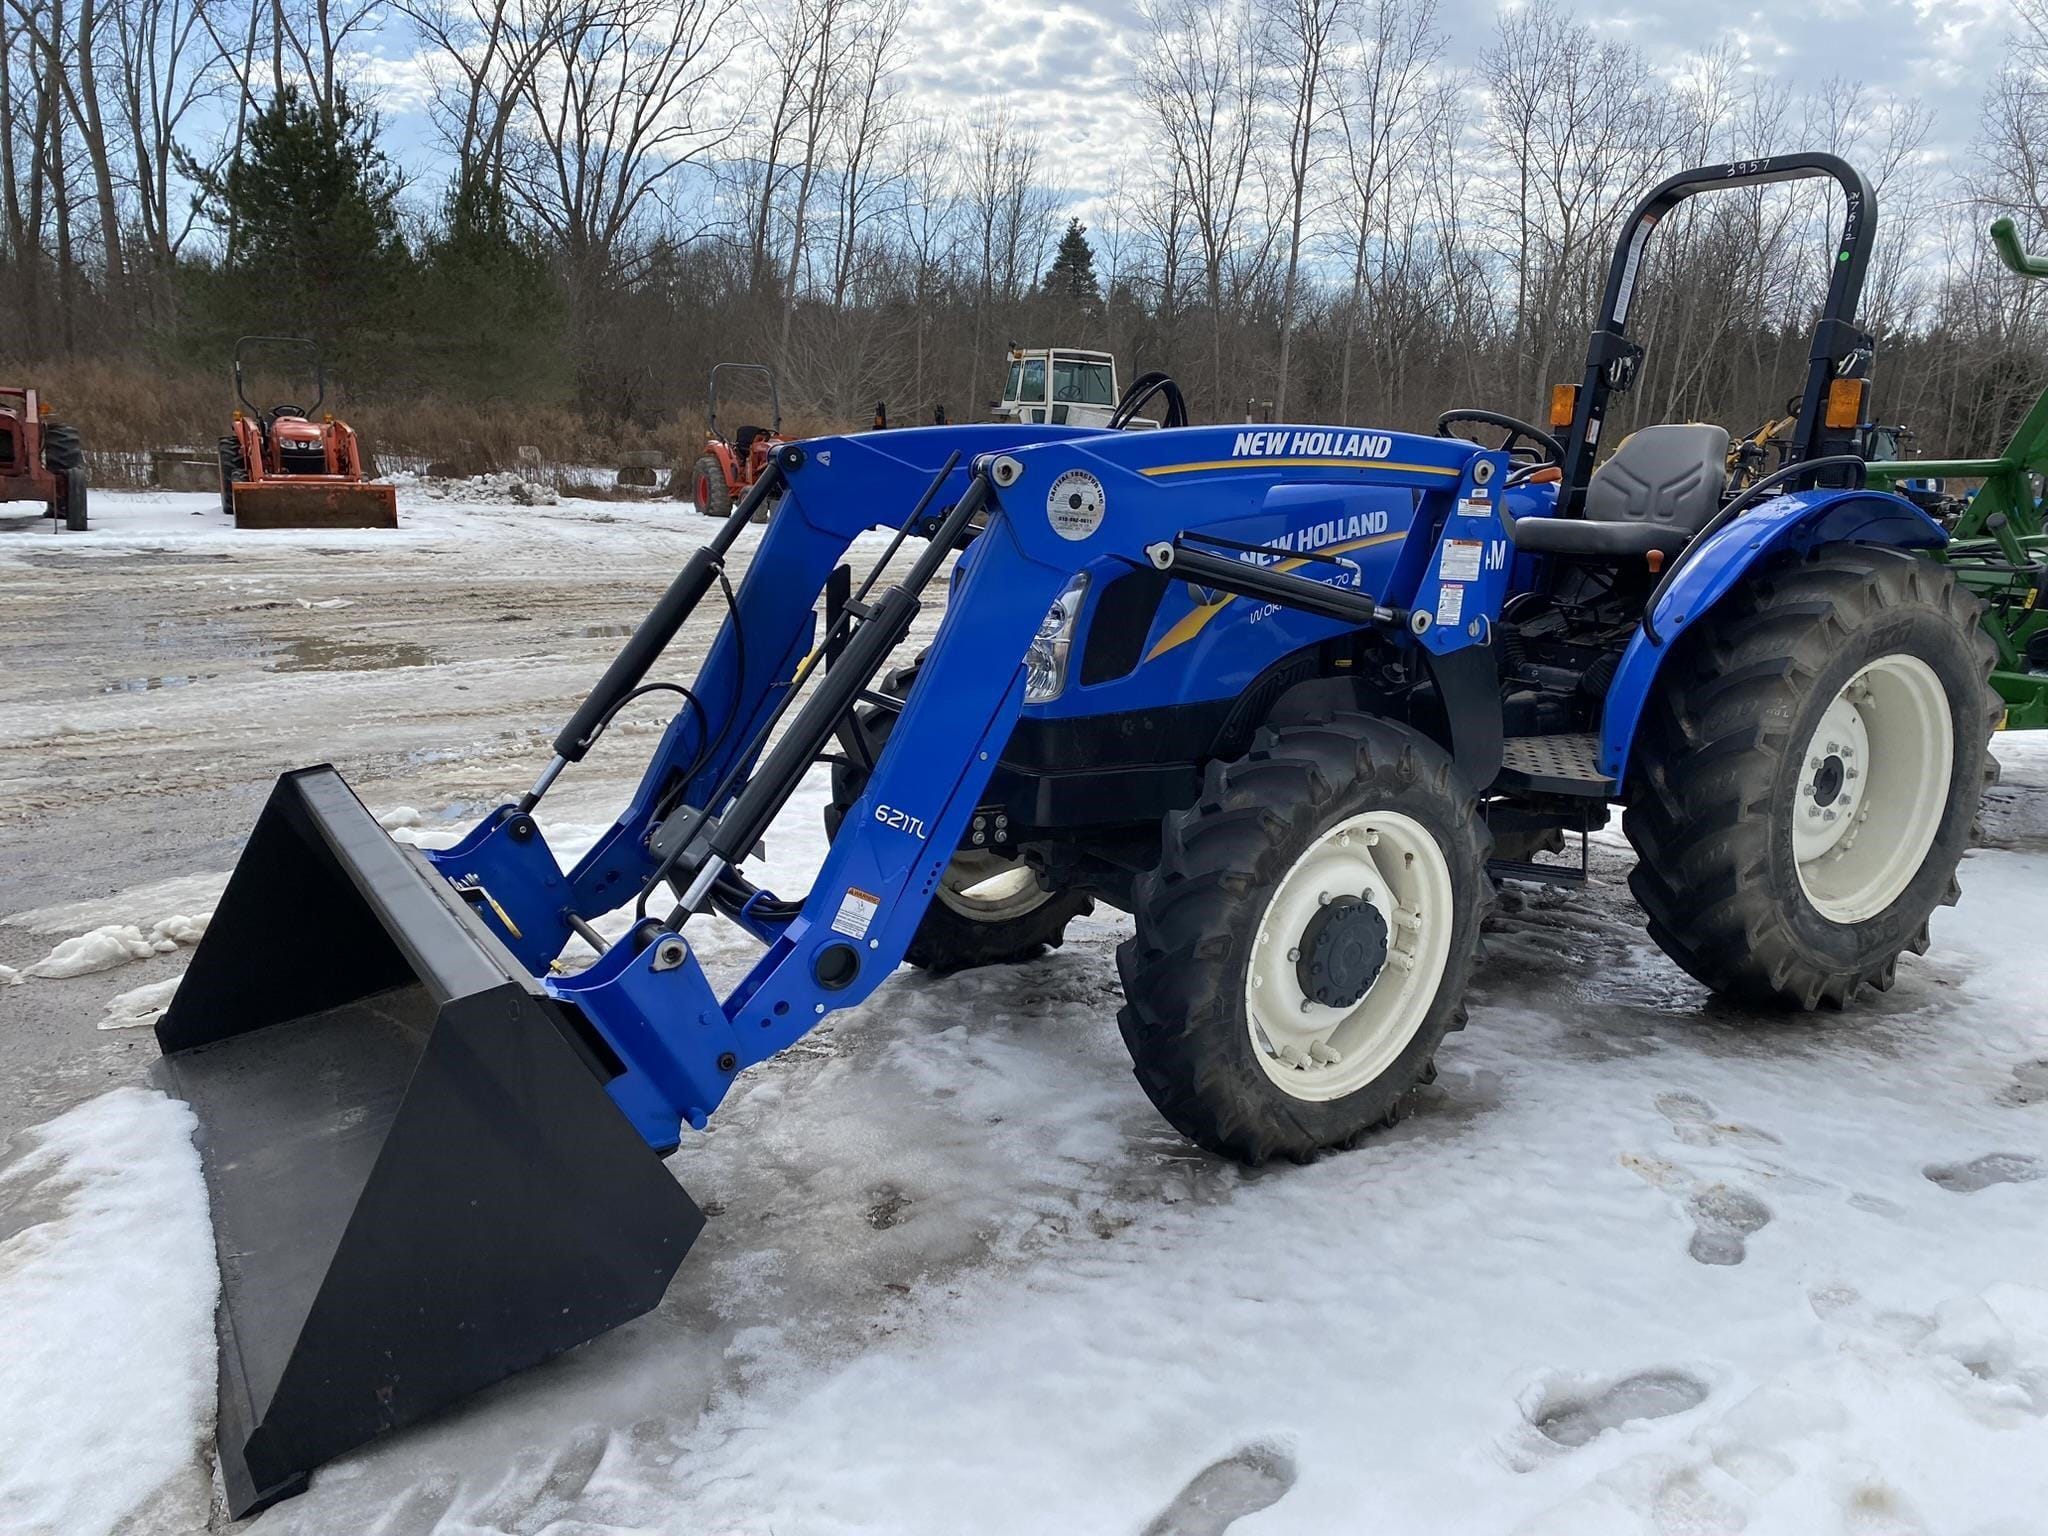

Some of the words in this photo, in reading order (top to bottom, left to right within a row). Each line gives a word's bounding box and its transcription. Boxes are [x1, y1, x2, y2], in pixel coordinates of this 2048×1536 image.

[1727, 158, 1770, 177] 3957
[1232, 432, 1290, 457] NEW
[1290, 432, 1392, 459] HOLLAND
[1298, 510, 1388, 552] HOLLAND
[1335, 573, 1349, 586] 70
[875, 804, 926, 840] 621TL
